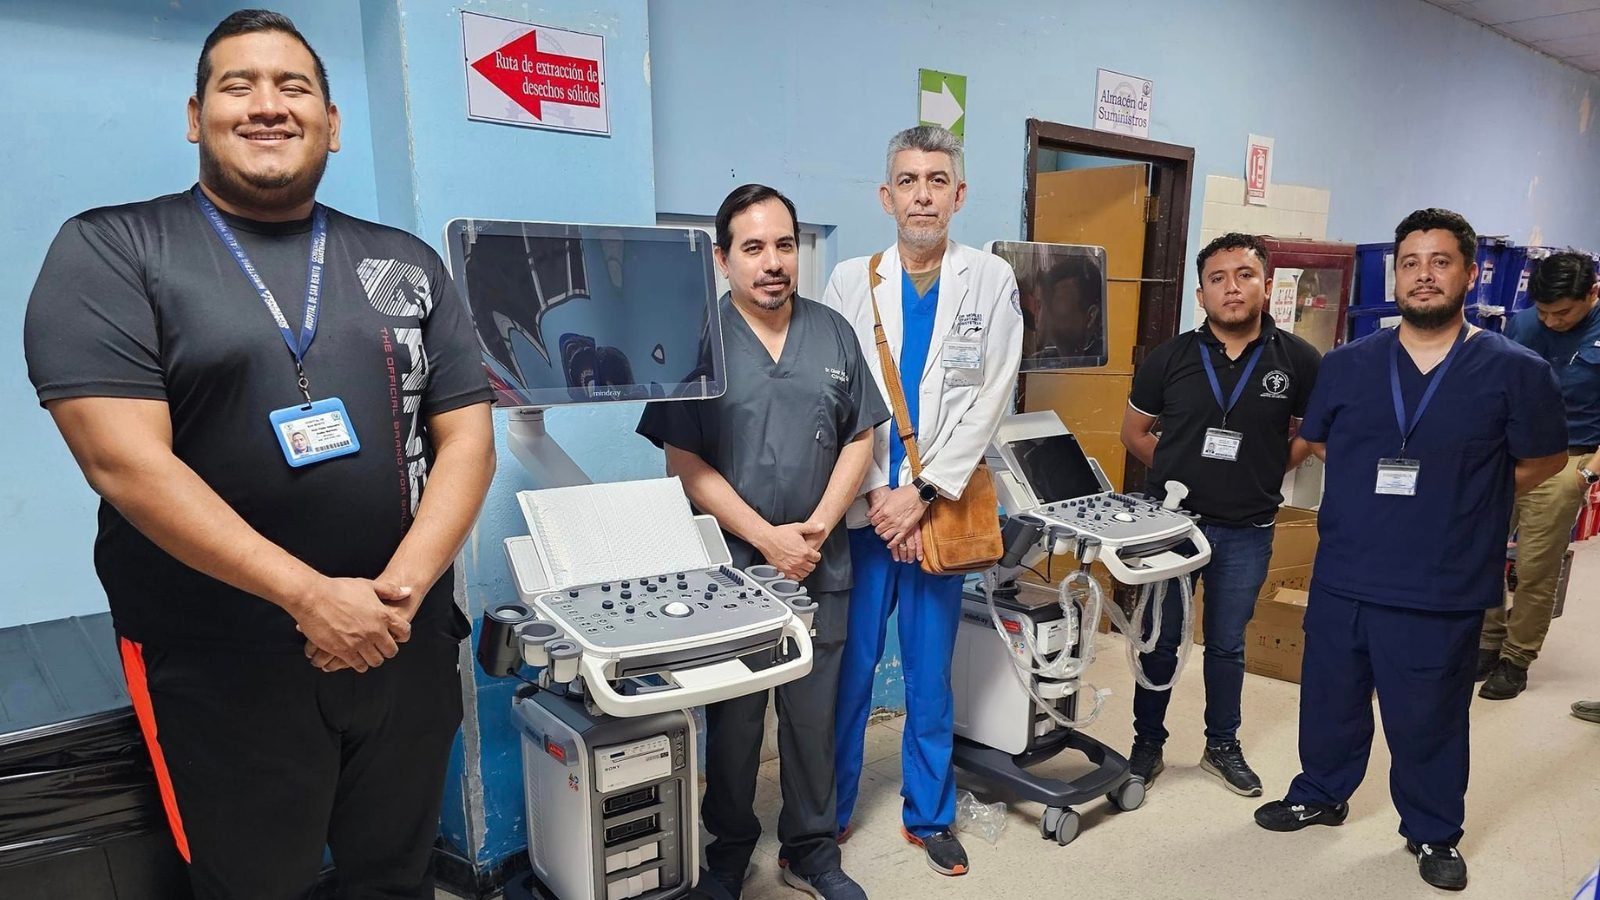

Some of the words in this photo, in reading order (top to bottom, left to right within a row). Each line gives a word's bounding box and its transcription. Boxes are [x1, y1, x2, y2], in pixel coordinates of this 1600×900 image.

[495, 51, 518, 71] Ruta
[521, 54, 533, 73] de
[536, 63, 584, 82] extracción
[587, 65, 598, 82] de
[522, 77, 564, 99] desechos
[567, 84, 599, 104] sólidos
[1101, 89, 1135, 109] Almacén
[1138, 97, 1147, 111] de
[1098, 106, 1147, 128] Suministros
[310, 265, 322, 284] BENITO
[307, 296, 318, 304] DE
[308, 285, 319, 296] SAN
[304, 304, 317, 331] HOSPITAL
[380, 326, 393, 352] THE
[386, 357, 399, 416] OFFICIAL
[593, 389, 621, 398] mindray
[393, 421, 403, 466] BRAND
[398, 469, 407, 496] FOR
